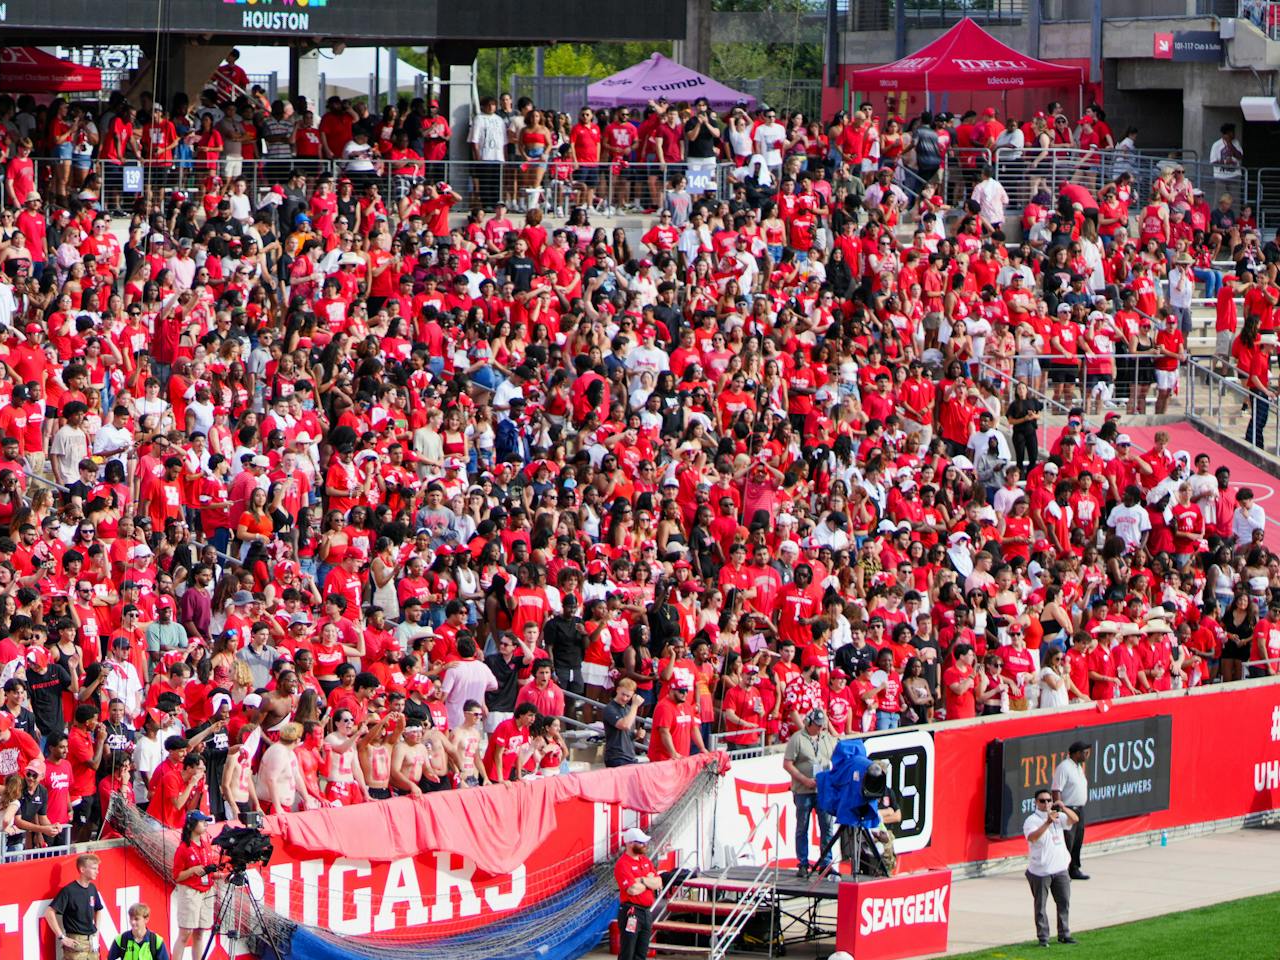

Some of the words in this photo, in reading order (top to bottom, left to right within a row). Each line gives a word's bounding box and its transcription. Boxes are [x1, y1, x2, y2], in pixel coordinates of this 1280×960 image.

[242, 11, 309, 30] HOUSTON
[952, 59, 1028, 70] TDECU
[641, 76, 707, 93] crumbl
[987, 76, 1024, 86] tdecu.org
[125, 170, 142, 185] 139
[688, 175, 709, 189] 140
[1103, 737, 1156, 775] GUSS
[1089, 787, 1117, 801] INJURY
[1118, 778, 1152, 796] LAWYERS
[859, 884, 949, 936] SEATGEEK
